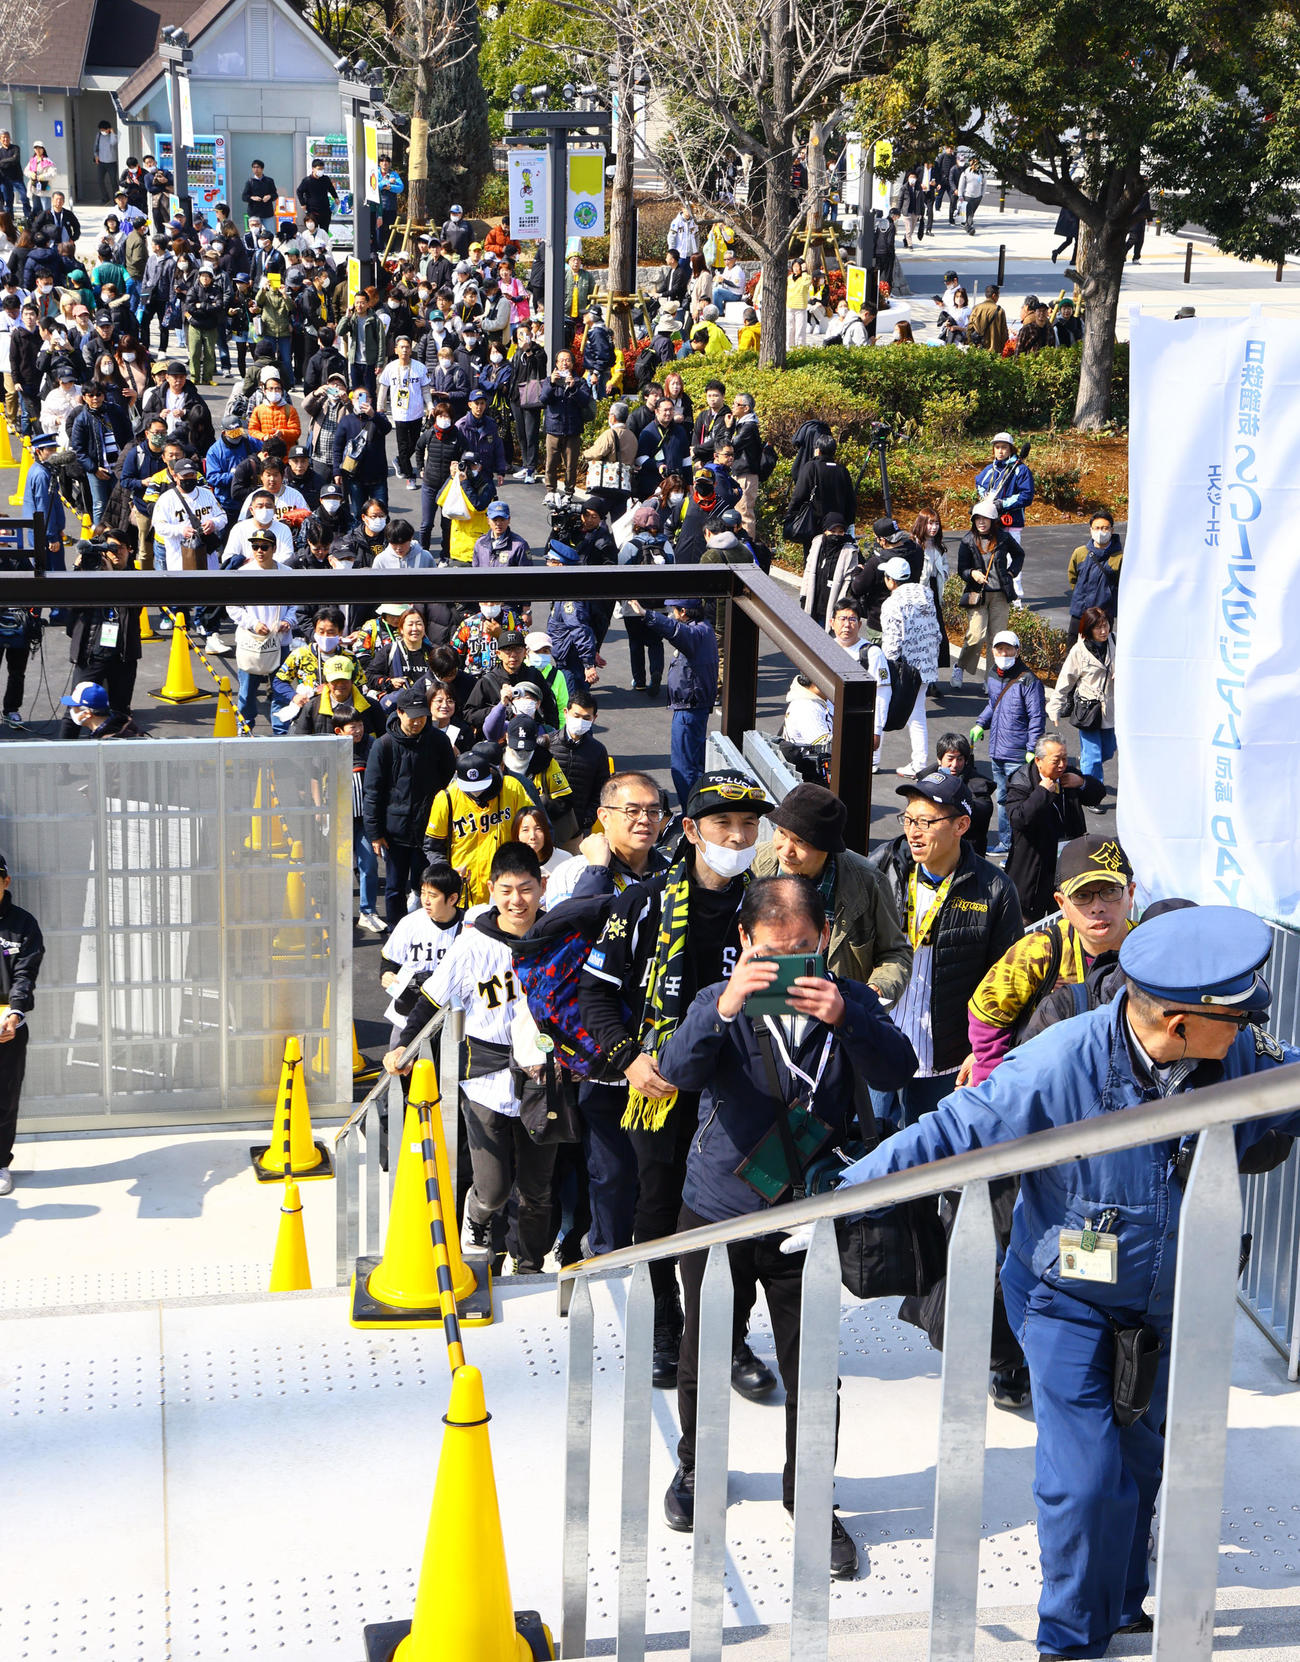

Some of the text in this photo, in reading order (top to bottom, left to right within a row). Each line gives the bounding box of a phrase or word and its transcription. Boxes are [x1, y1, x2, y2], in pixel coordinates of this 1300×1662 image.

[391, 376, 420, 388] Tgers
[175, 504, 214, 523] Tger
[453, 806, 512, 839] Tigers
[951, 896, 989, 913] Tigers
